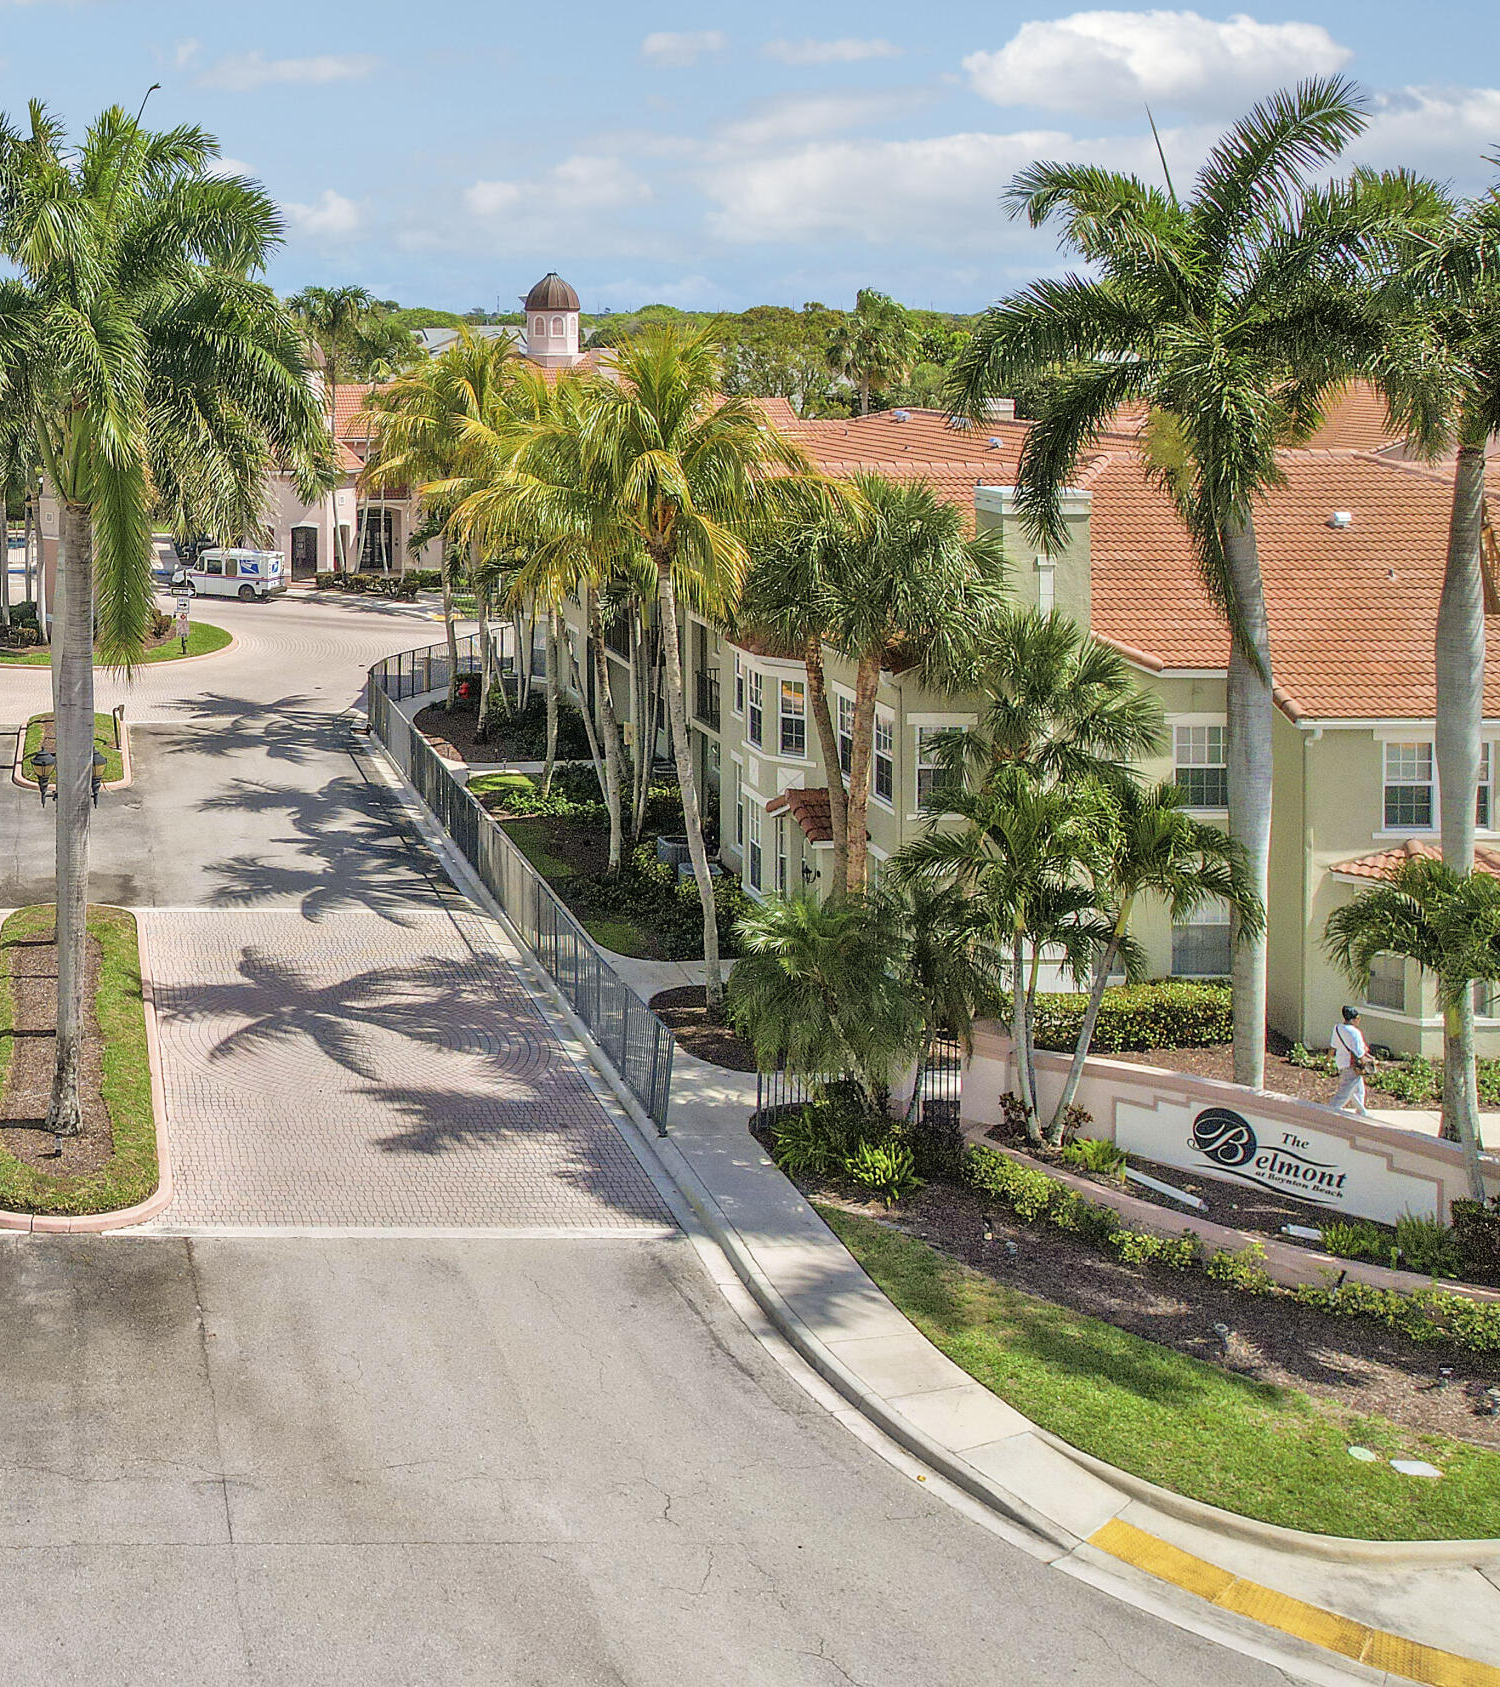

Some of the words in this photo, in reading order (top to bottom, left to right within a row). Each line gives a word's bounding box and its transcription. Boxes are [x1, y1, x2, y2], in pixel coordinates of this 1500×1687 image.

[1187, 1116, 1347, 1189] Belmont
[1282, 1132, 1310, 1149] The
[1255, 1170, 1266, 1178] at
[1267, 1172, 1309, 1190] Boynton
[1311, 1184, 1343, 1198] Beach
